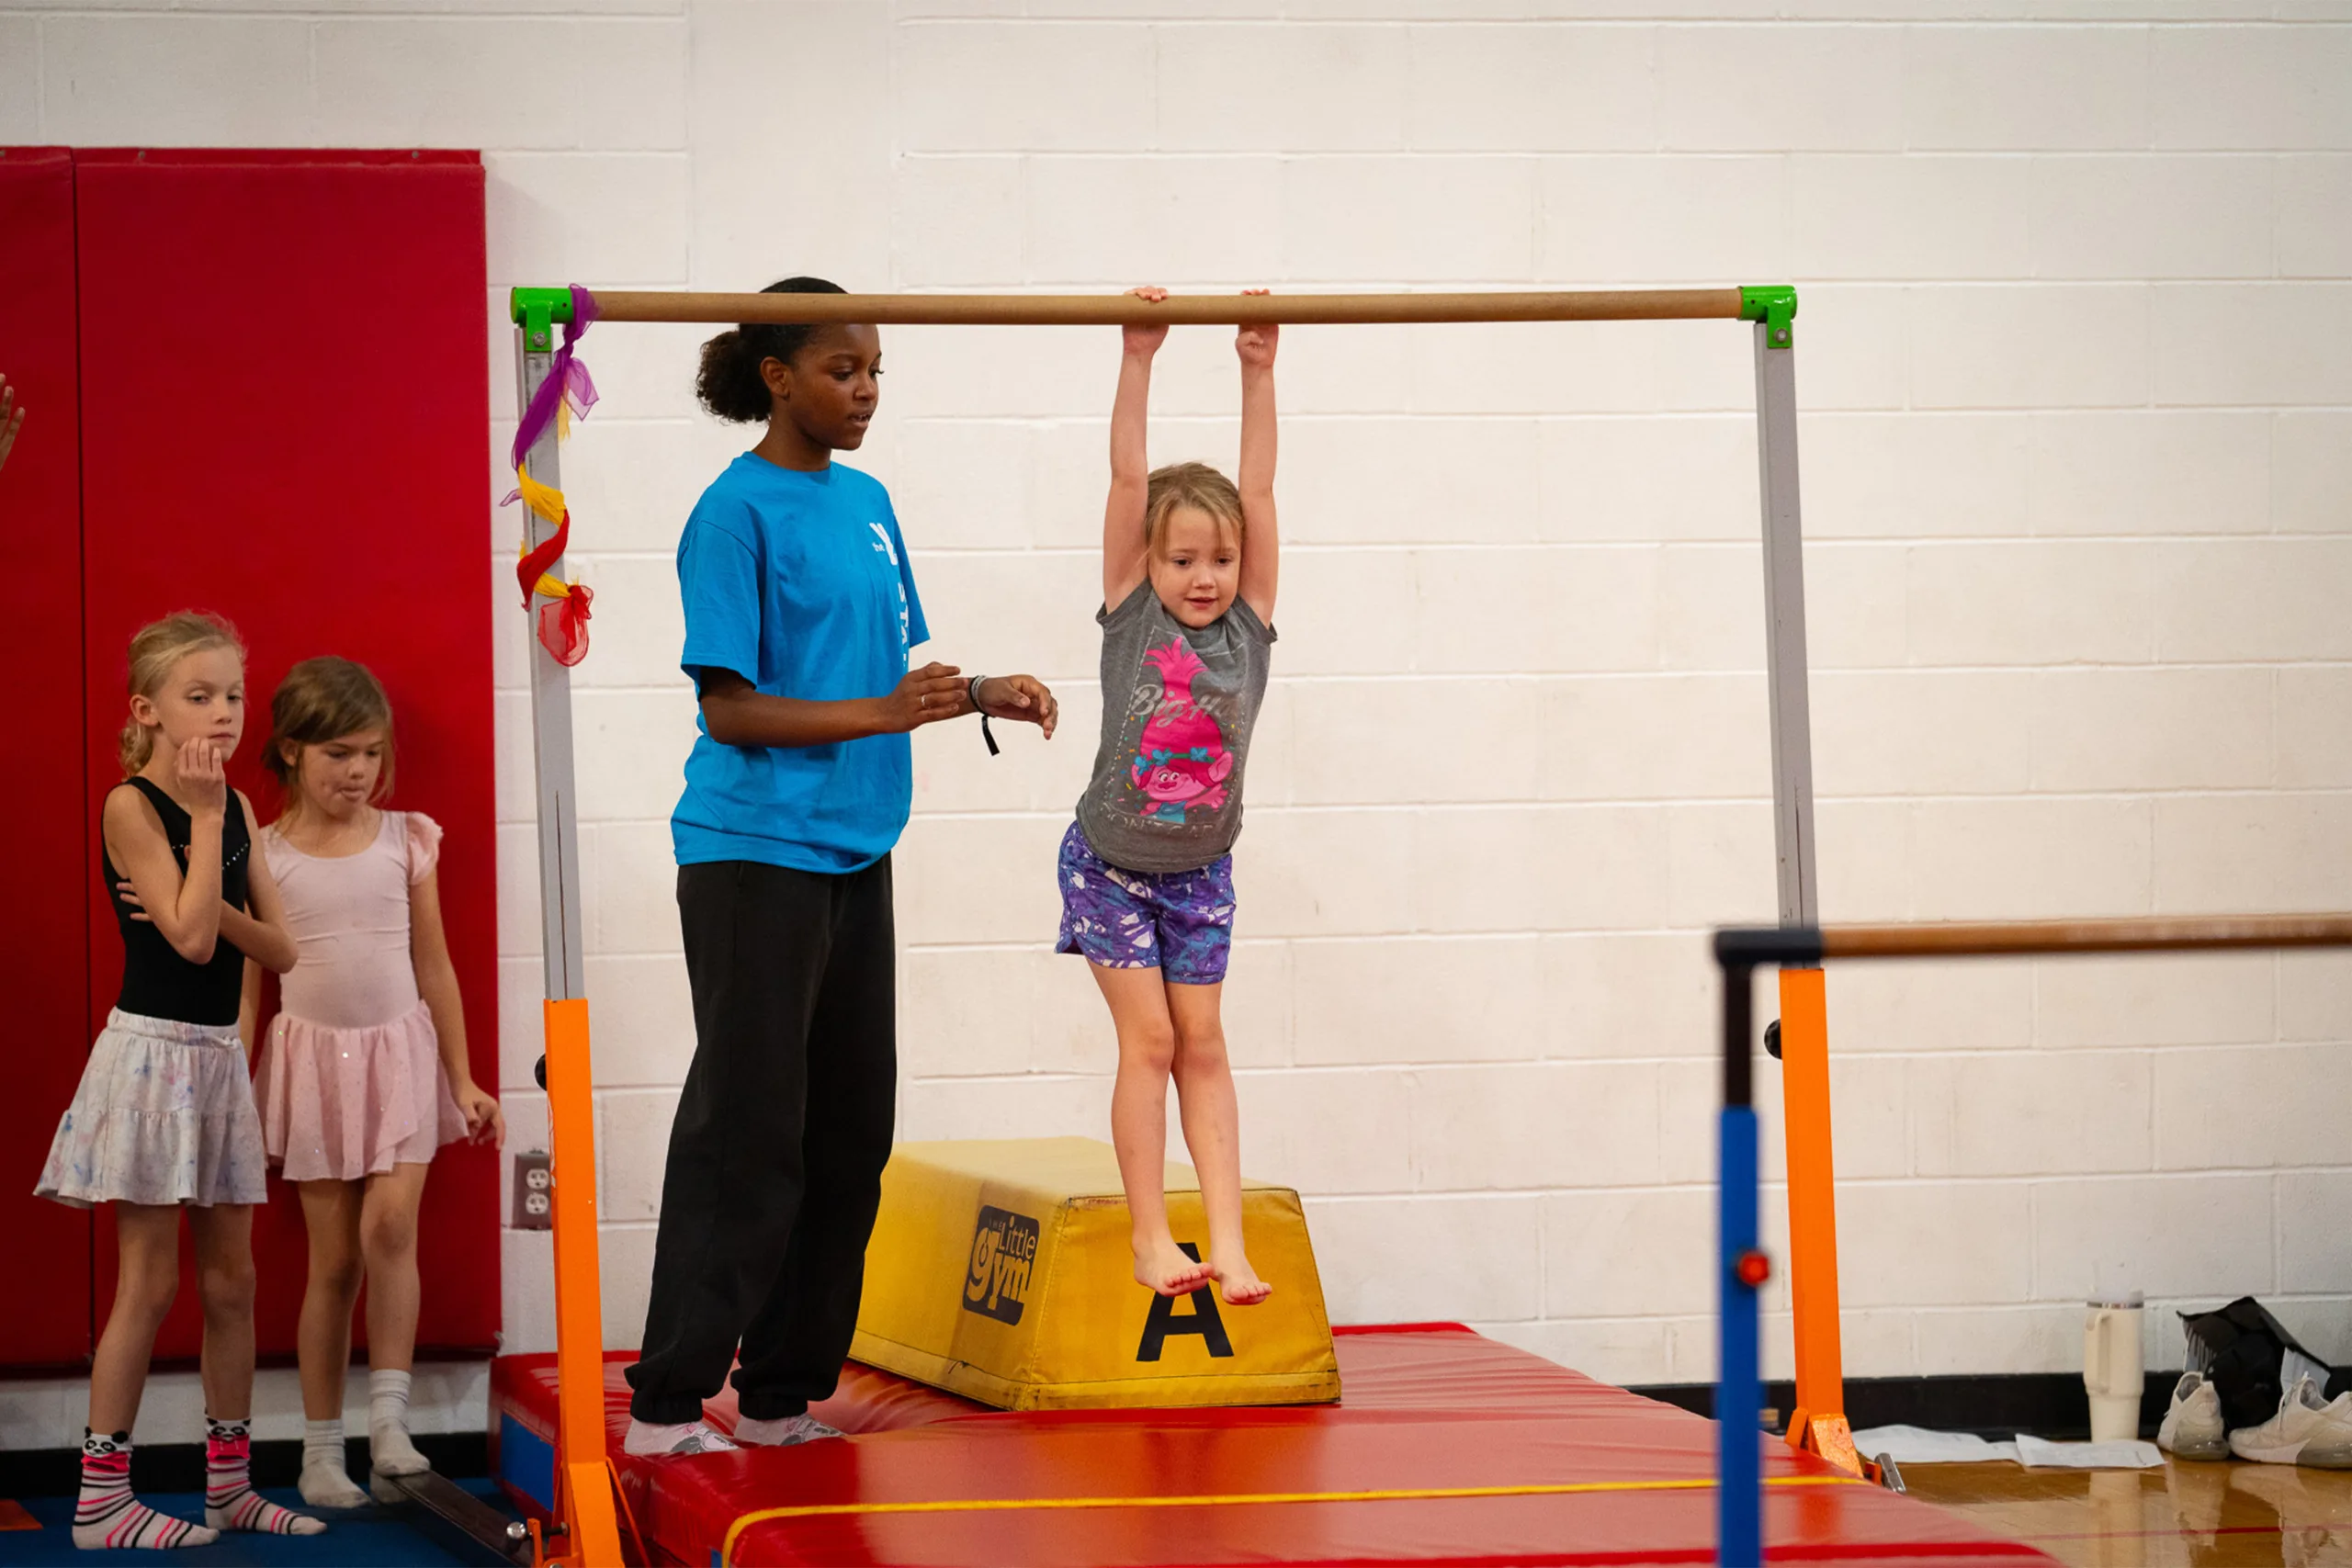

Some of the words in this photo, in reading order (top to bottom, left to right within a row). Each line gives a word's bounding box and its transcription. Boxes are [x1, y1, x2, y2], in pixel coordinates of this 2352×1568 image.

[897, 581, 909, 669] STA
[1130, 683, 1188, 728] Big
[967, 1226, 1031, 1311] gym
[999, 1215, 1036, 1259] Little
[1136, 1242, 1234, 1362] A
